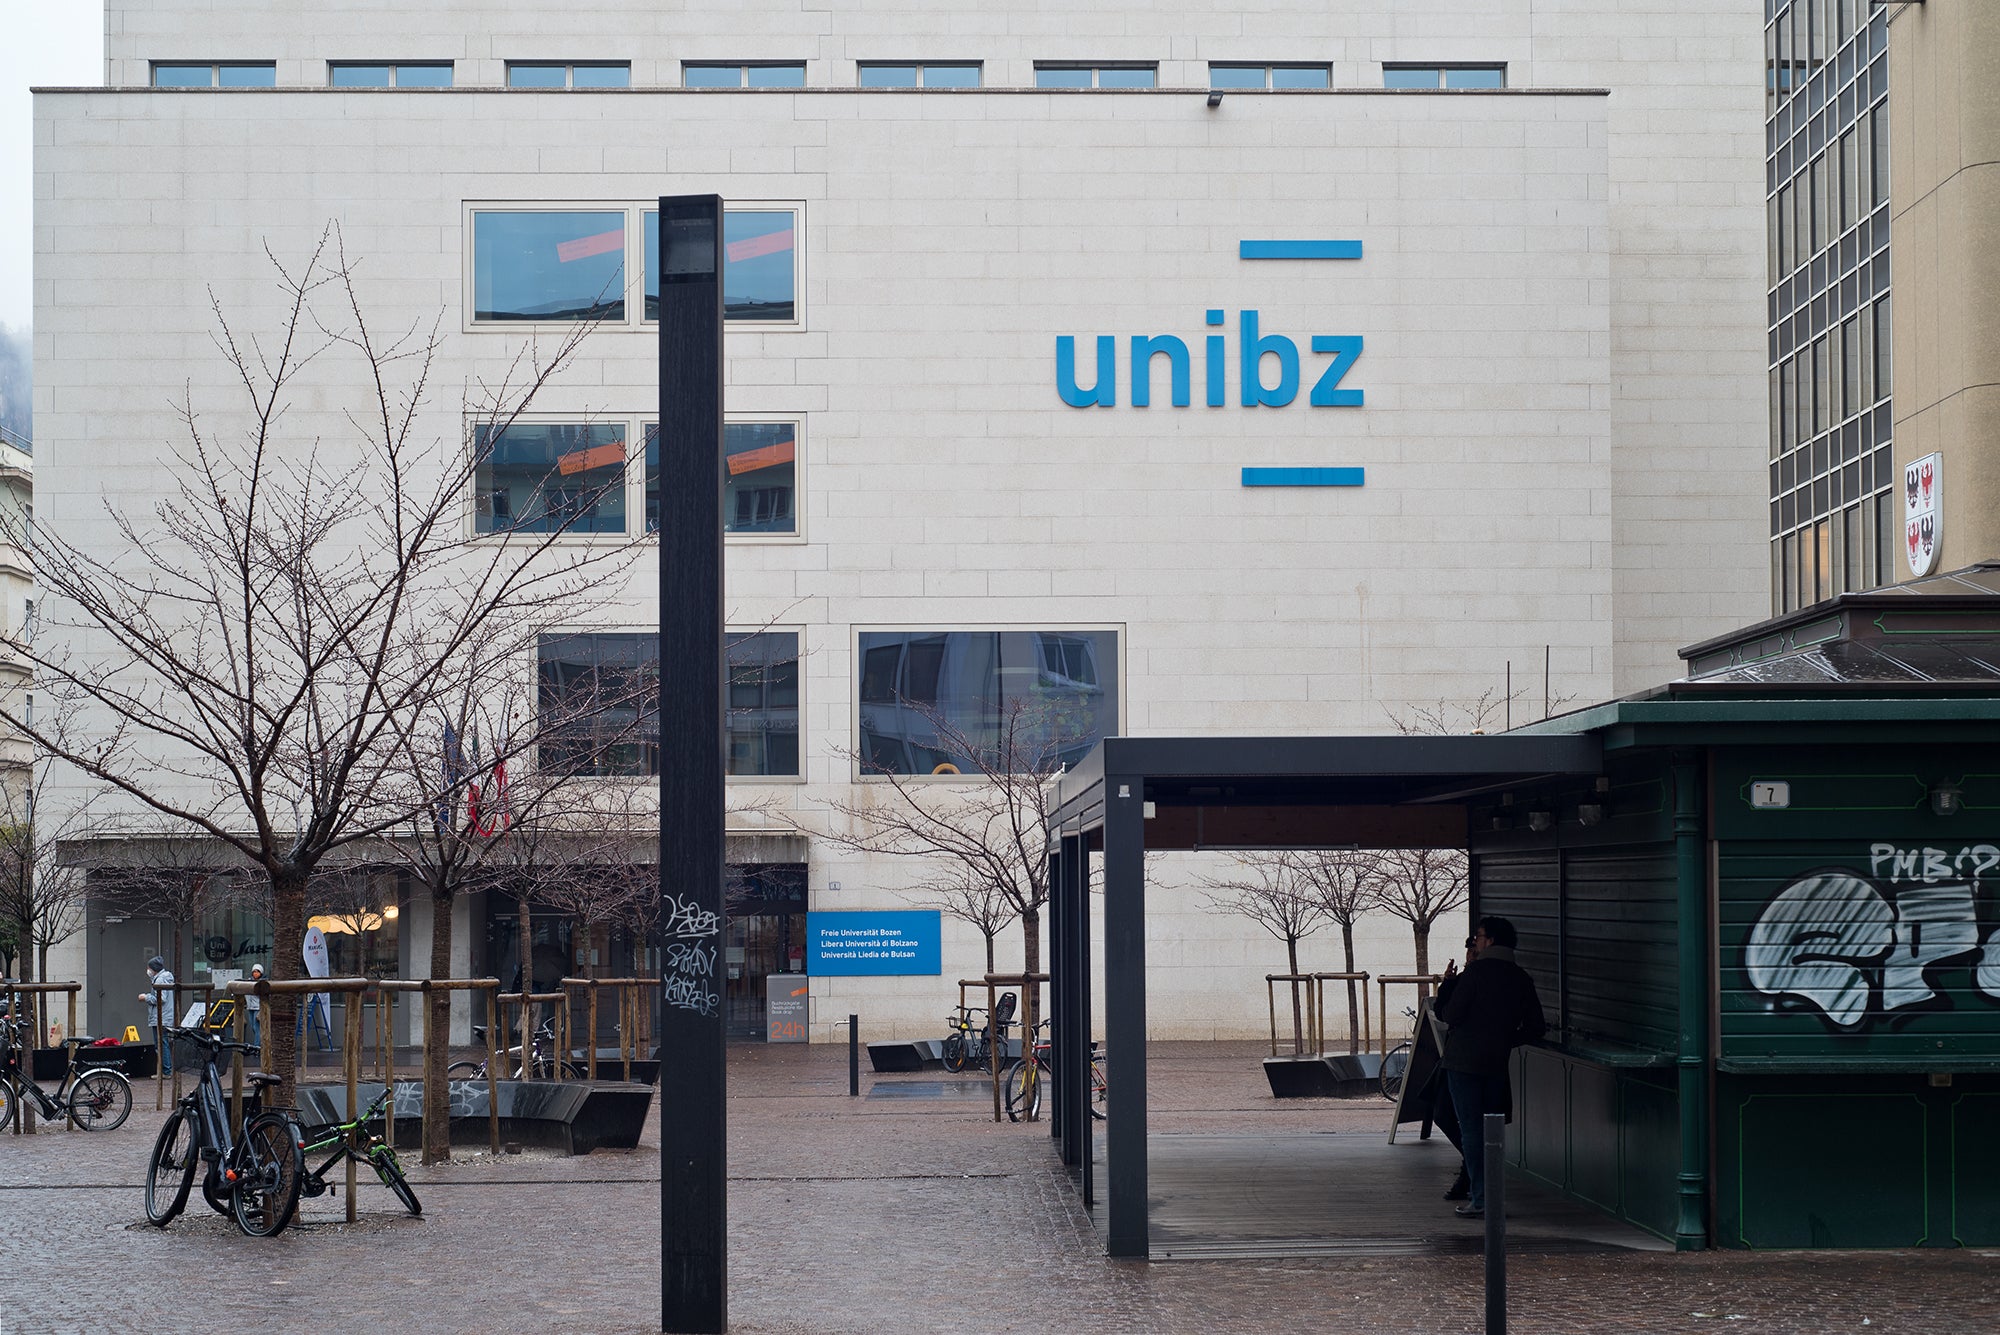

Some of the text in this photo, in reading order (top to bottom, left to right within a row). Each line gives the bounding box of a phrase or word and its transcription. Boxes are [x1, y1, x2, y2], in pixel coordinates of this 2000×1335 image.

[1056, 309, 1364, 408] unibz
[1767, 787, 1774, 802] 7
[820, 929, 839, 937] Freie
[840, 928, 879, 937] Universität
[210, 941, 226, 950] Uni
[820, 940, 844, 948] Libera
[845, 939, 881, 948] Università
[209, 950, 226, 959] Bar
[820, 951, 857, 959] Università
[858, 951, 879, 959] Liedia
[890, 950, 916, 958] Bulsan
[771, 1020, 805, 1039] 24h
